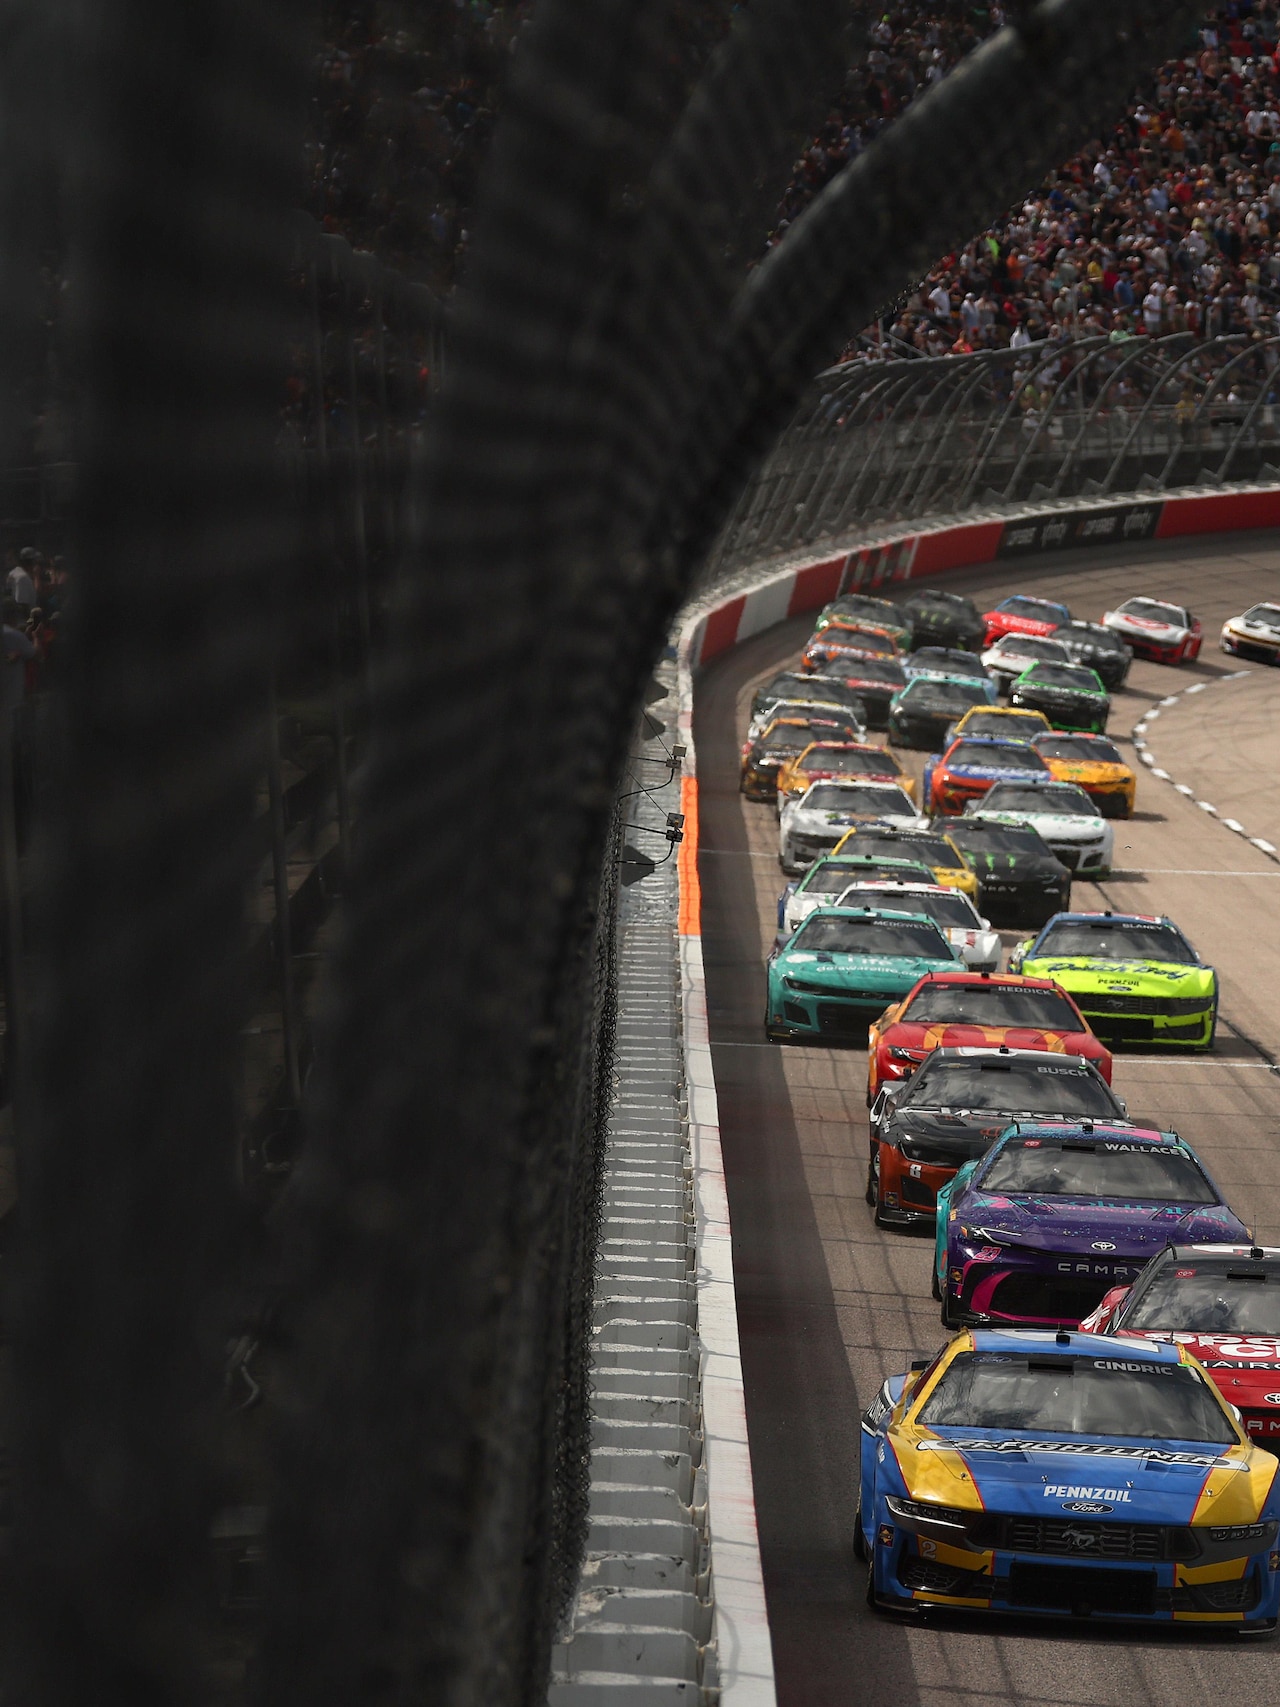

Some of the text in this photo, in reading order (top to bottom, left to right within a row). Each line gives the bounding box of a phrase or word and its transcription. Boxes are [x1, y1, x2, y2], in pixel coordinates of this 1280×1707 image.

[998, 986, 1051, 996] REDDICK
[1037, 1066, 1090, 1078] BUSCH
[1105, 1142, 1181, 1156] WALLACE
[973, 1246, 1002, 1261] 23
[1093, 1360, 1174, 1376] CINDRIC
[1043, 1485, 1132, 1503] PENNZOIL
[1071, 1502, 1104, 1513] Ford
[922, 1541, 937, 1559] 2
